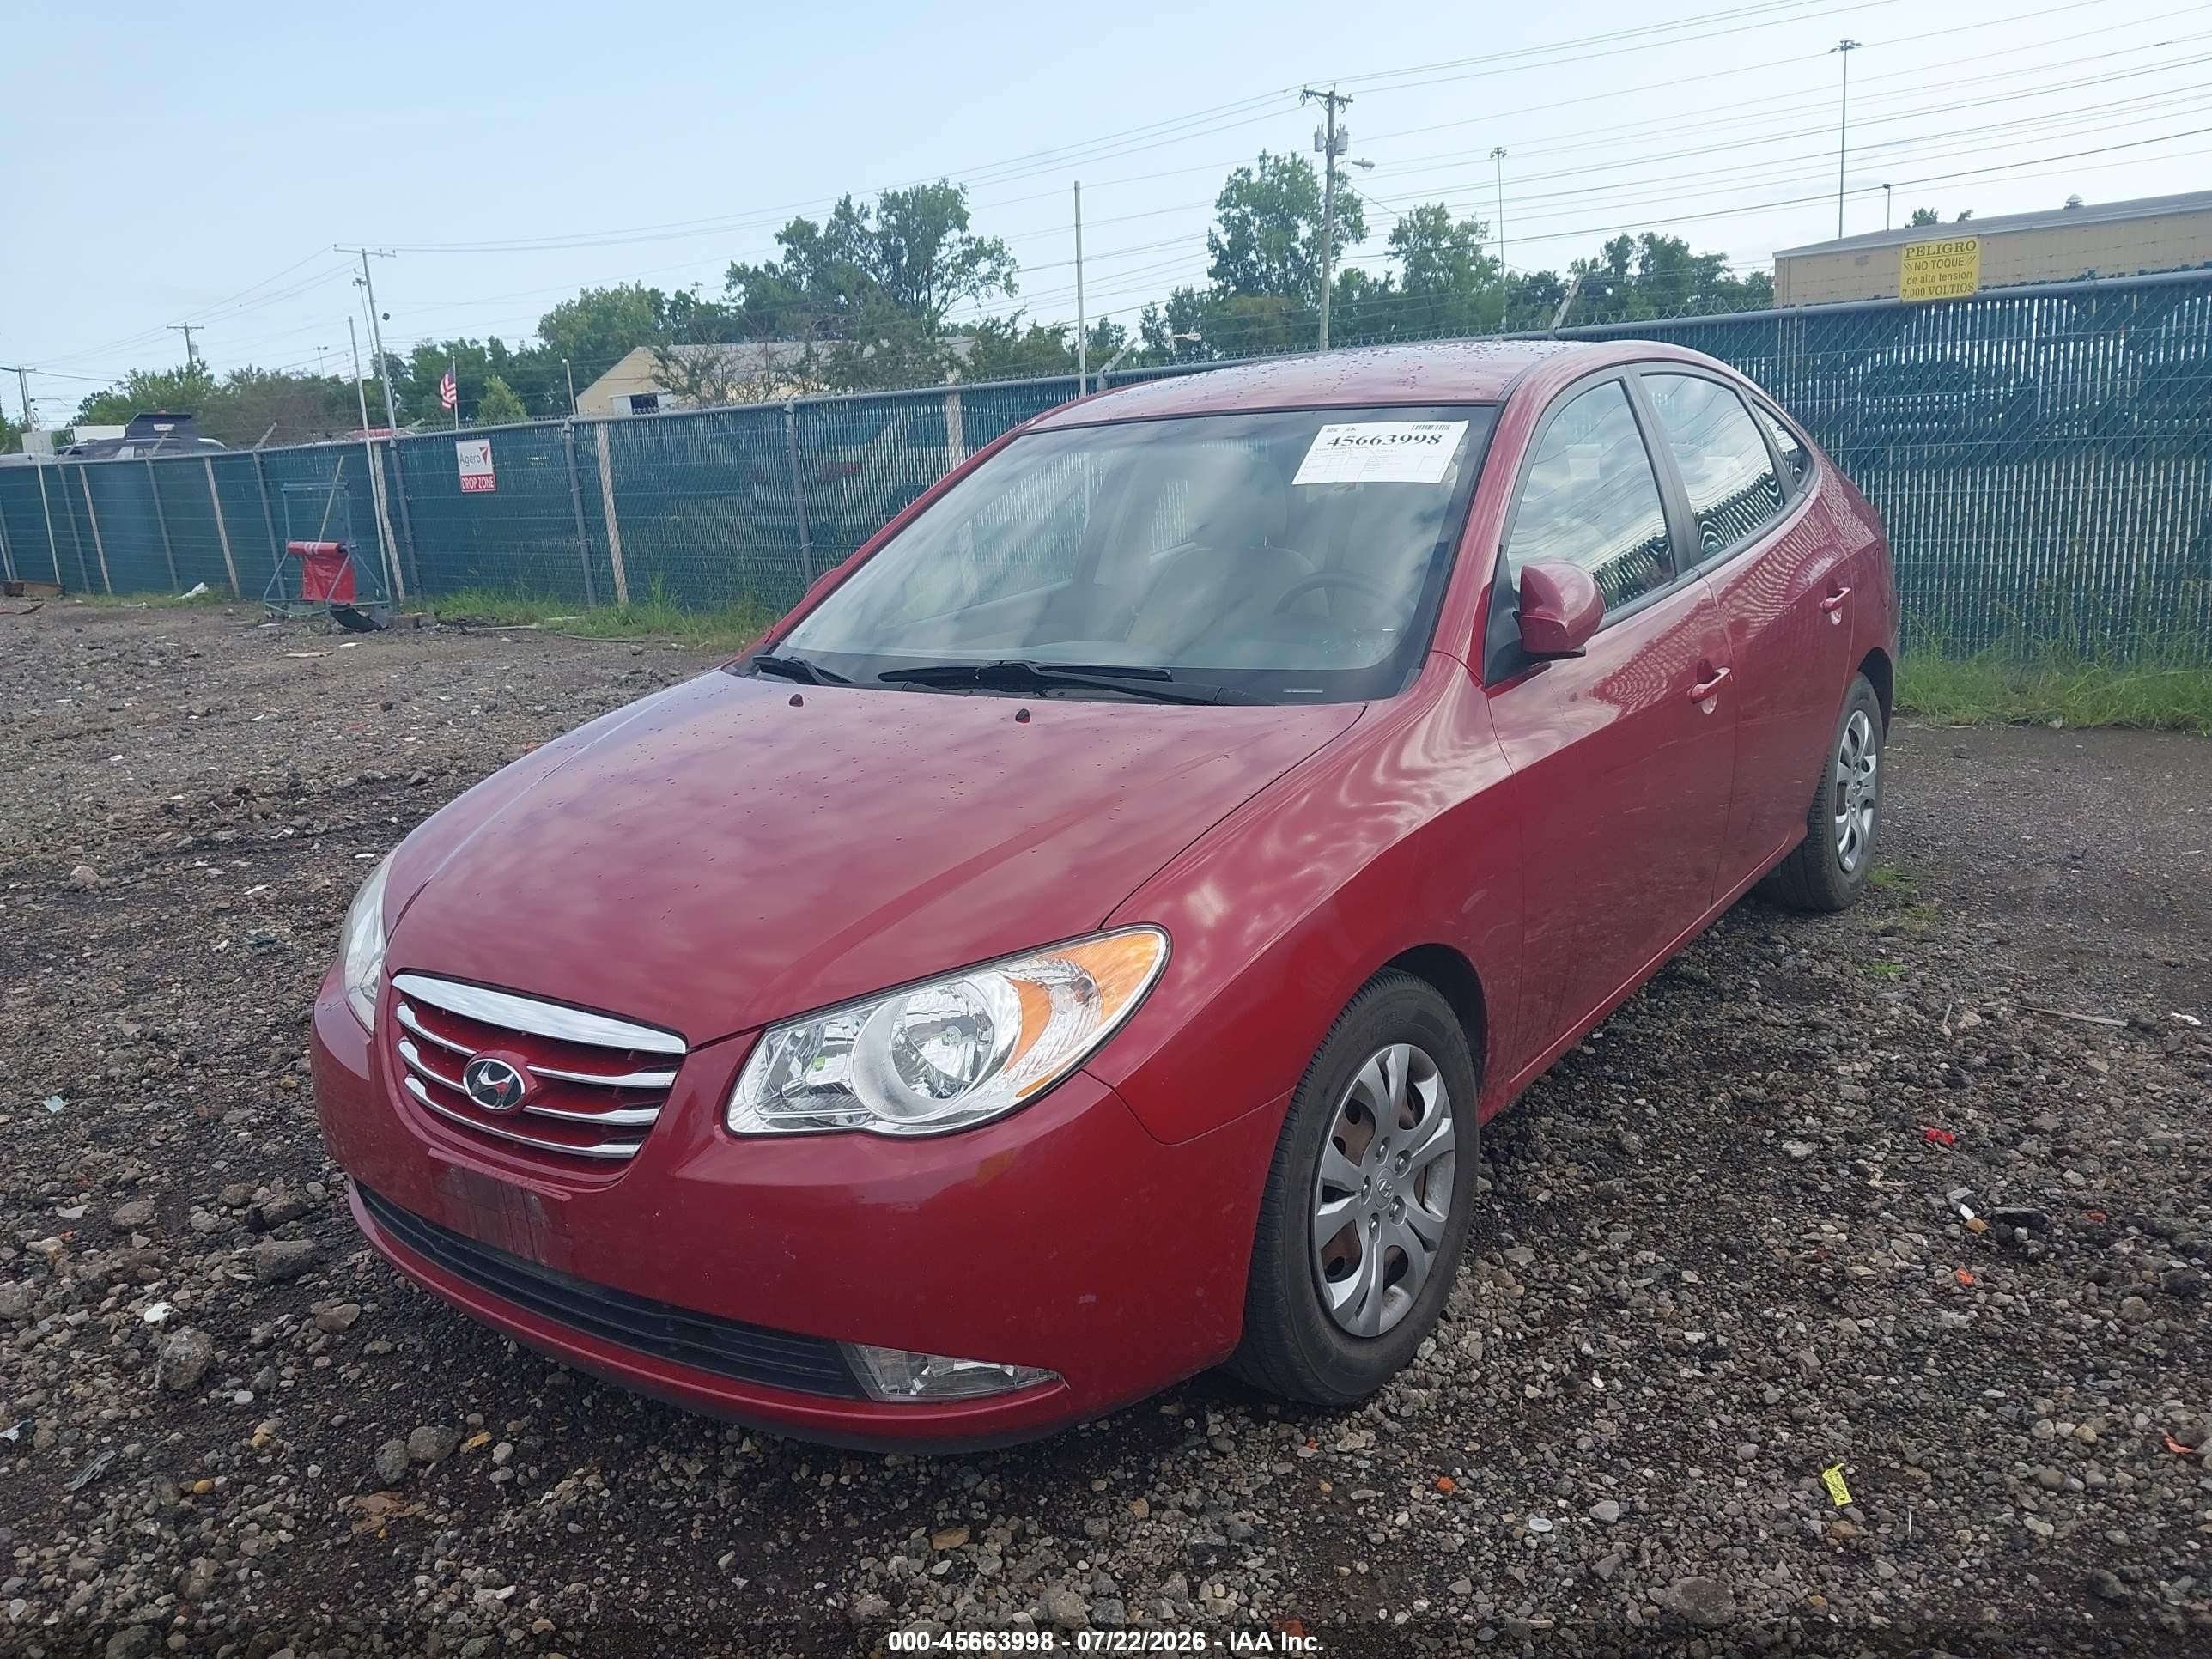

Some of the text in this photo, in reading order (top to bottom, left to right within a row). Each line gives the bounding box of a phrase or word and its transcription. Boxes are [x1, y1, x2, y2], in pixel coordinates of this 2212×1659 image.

[1905, 240, 1977, 258] PELIGRO
[1914, 257, 1965, 271] NO TOQUE
[1906, 271, 1972, 285] de alta tension
[1929, 282, 1974, 295] VOLTIOS
[1327, 434, 1443, 447] 45663998
[459, 453, 482, 467] Agero
[461, 476, 495, 489] DROP ZONE
